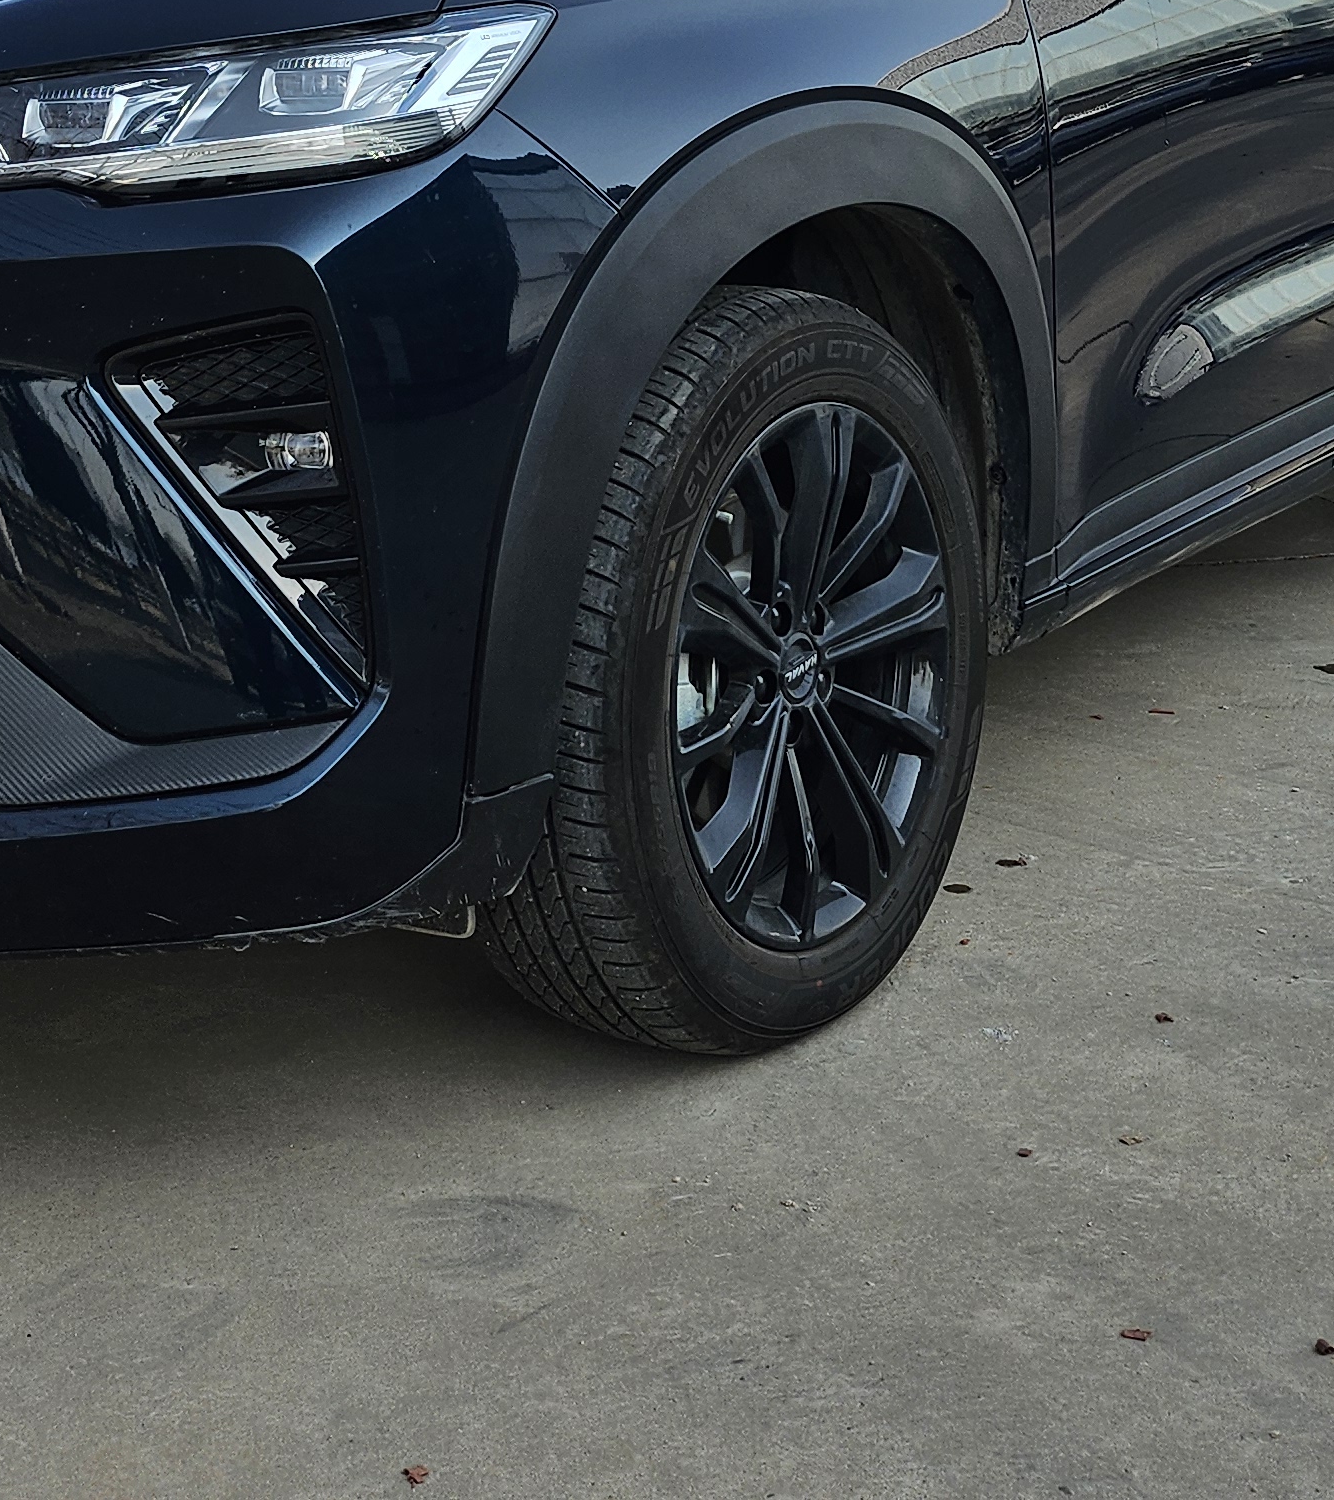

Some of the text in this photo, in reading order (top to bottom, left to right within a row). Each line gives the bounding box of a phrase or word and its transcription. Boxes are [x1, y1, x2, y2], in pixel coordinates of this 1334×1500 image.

[684, 339, 874, 509] EVOLUTION CTT
[784, 653, 818, 683] HAVAL
